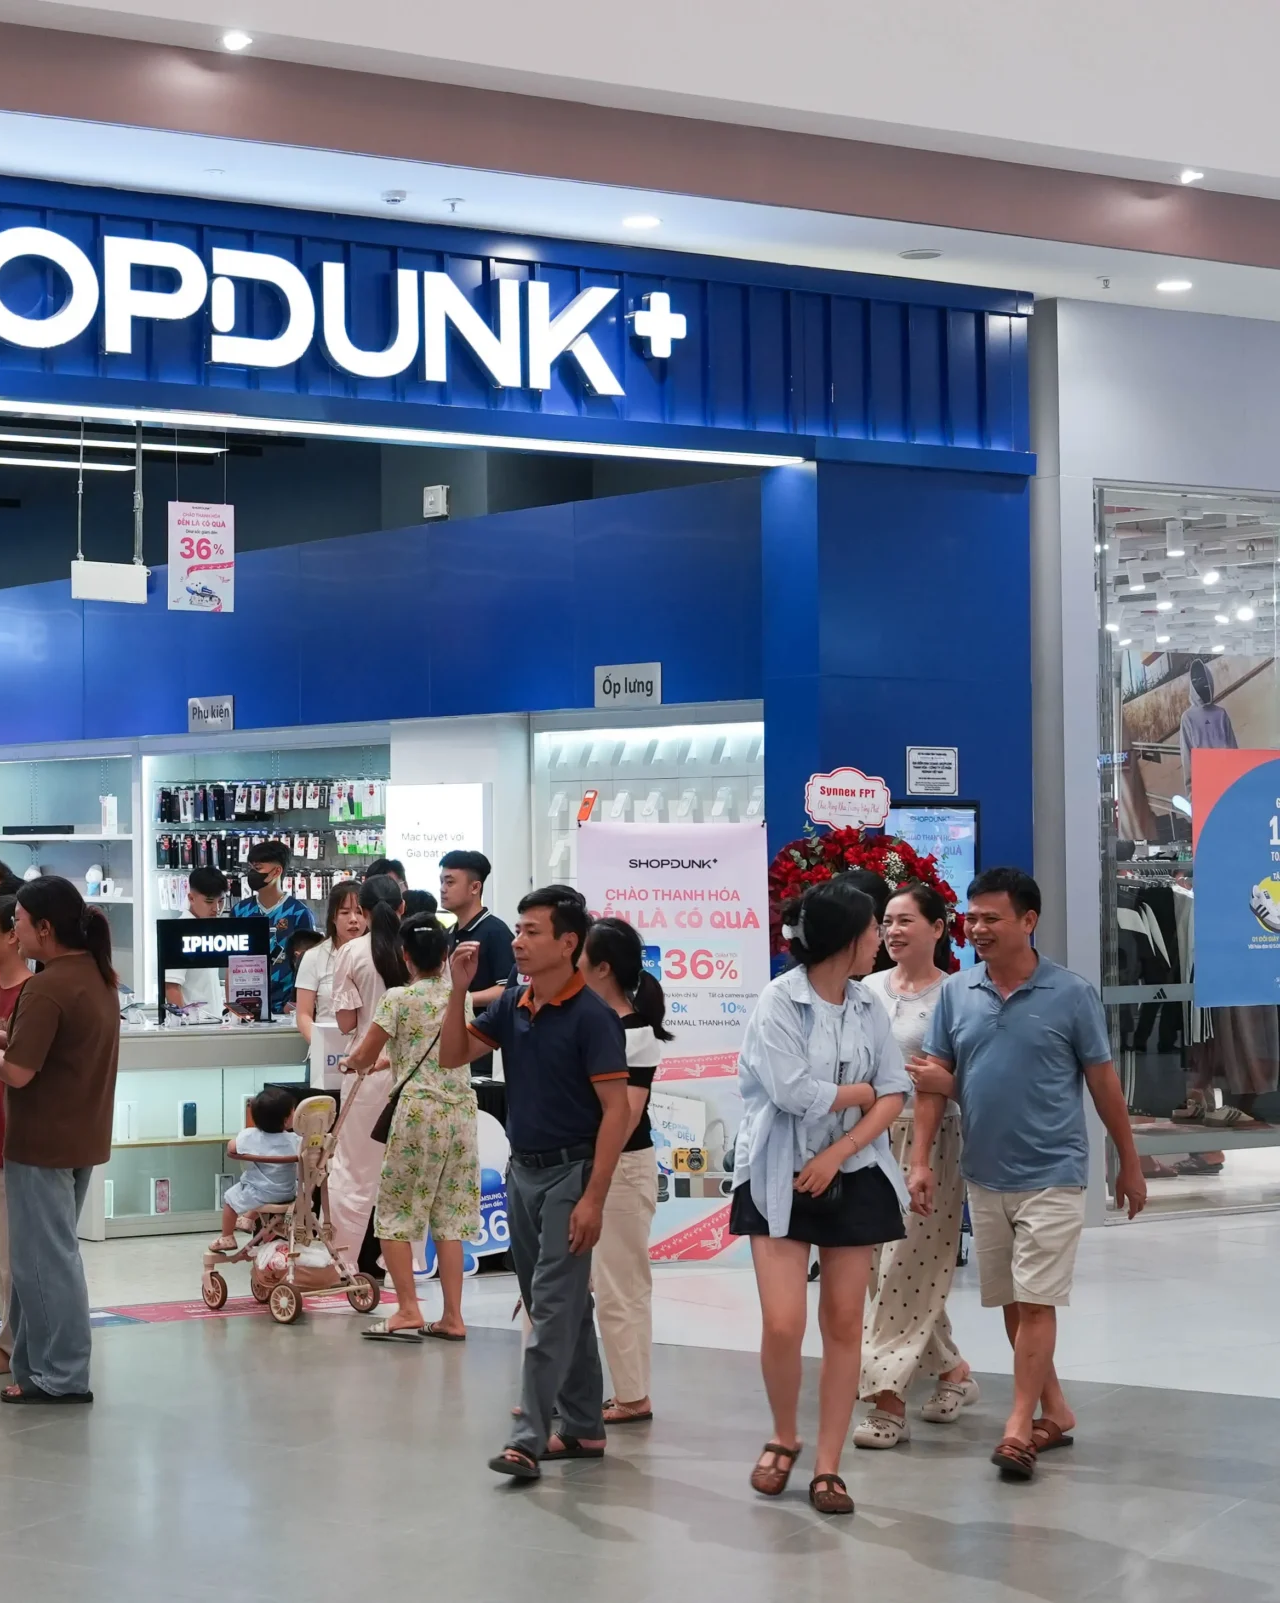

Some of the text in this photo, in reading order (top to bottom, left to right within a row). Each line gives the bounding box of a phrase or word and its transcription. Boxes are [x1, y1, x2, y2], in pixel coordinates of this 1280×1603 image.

[179, 537, 224, 560] 36%
[602, 673, 654, 699] Ốp lưng
[192, 704, 230, 724] Phụ kiện
[820, 785, 876, 799] Synnex FPT
[605, 886, 741, 901] CHÀO THANH HÓA
[637, 907, 668, 929] LÀ
[674, 907, 703, 929] CÓ
[709, 907, 760, 930] QUÀ
[181, 934, 250, 953] IPHONE
[664, 949, 738, 980] 36%
[720, 1002, 747, 1014] 10%
[724, 1018, 741, 1027] HÓA
